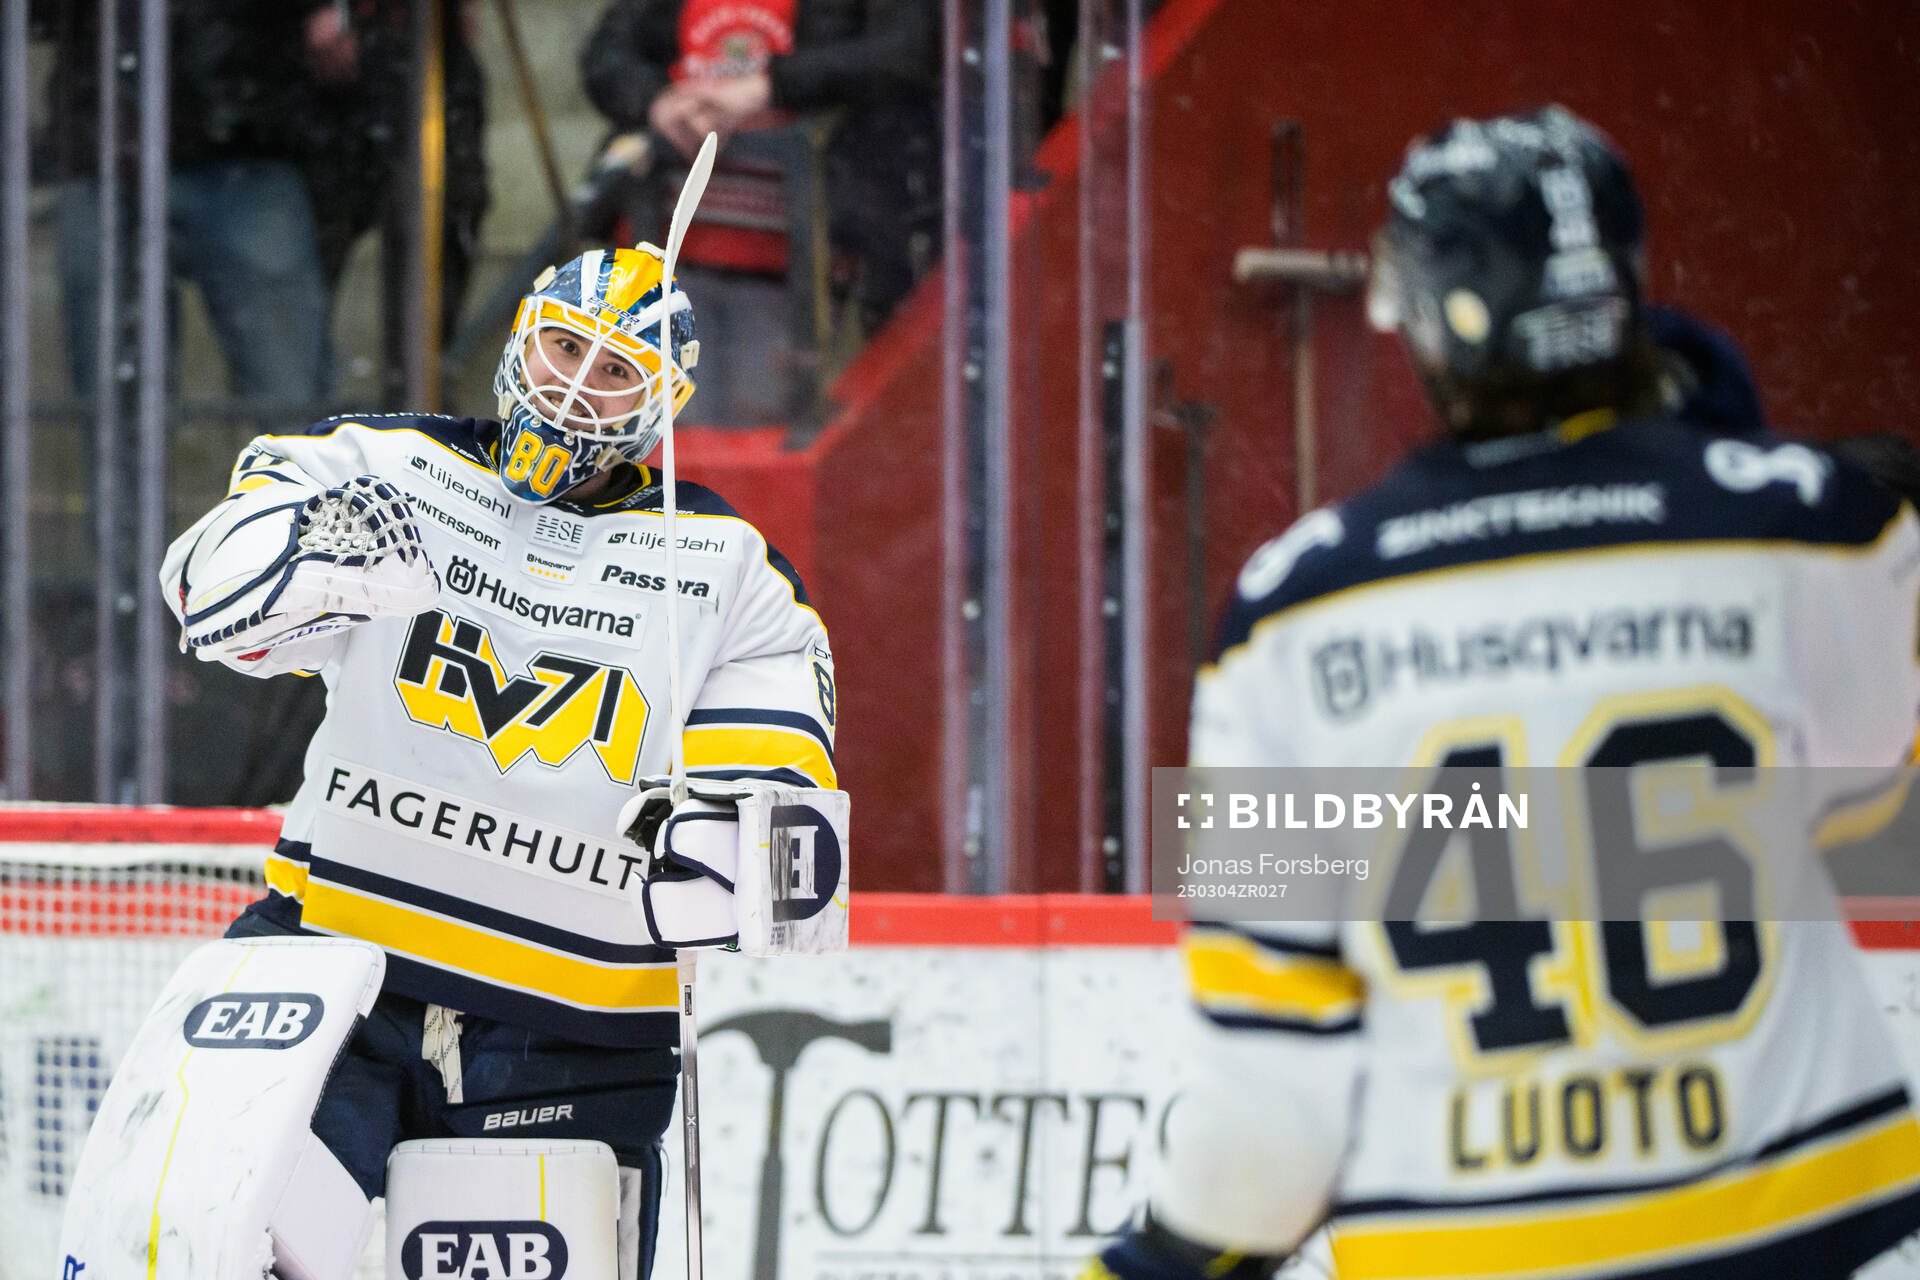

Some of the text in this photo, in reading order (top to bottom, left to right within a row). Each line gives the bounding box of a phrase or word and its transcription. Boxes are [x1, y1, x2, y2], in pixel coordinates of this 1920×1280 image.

[429, 463, 512, 520] Liljedahl
[505, 429, 573, 498] 80
[416, 498, 502, 551] INTERSPORT
[535, 514, 585, 544] HSE
[396, 607, 634, 754] HV71
[326, 767, 643, 891] FAGERHULT
[1375, 690, 1774, 1068] 46
[191, 1001, 312, 1040] EAB
[482, 1103, 574, 1132] BAUER
[1449, 1061, 1729, 1173] LUOTO
[418, 1232, 553, 1280] EAB
